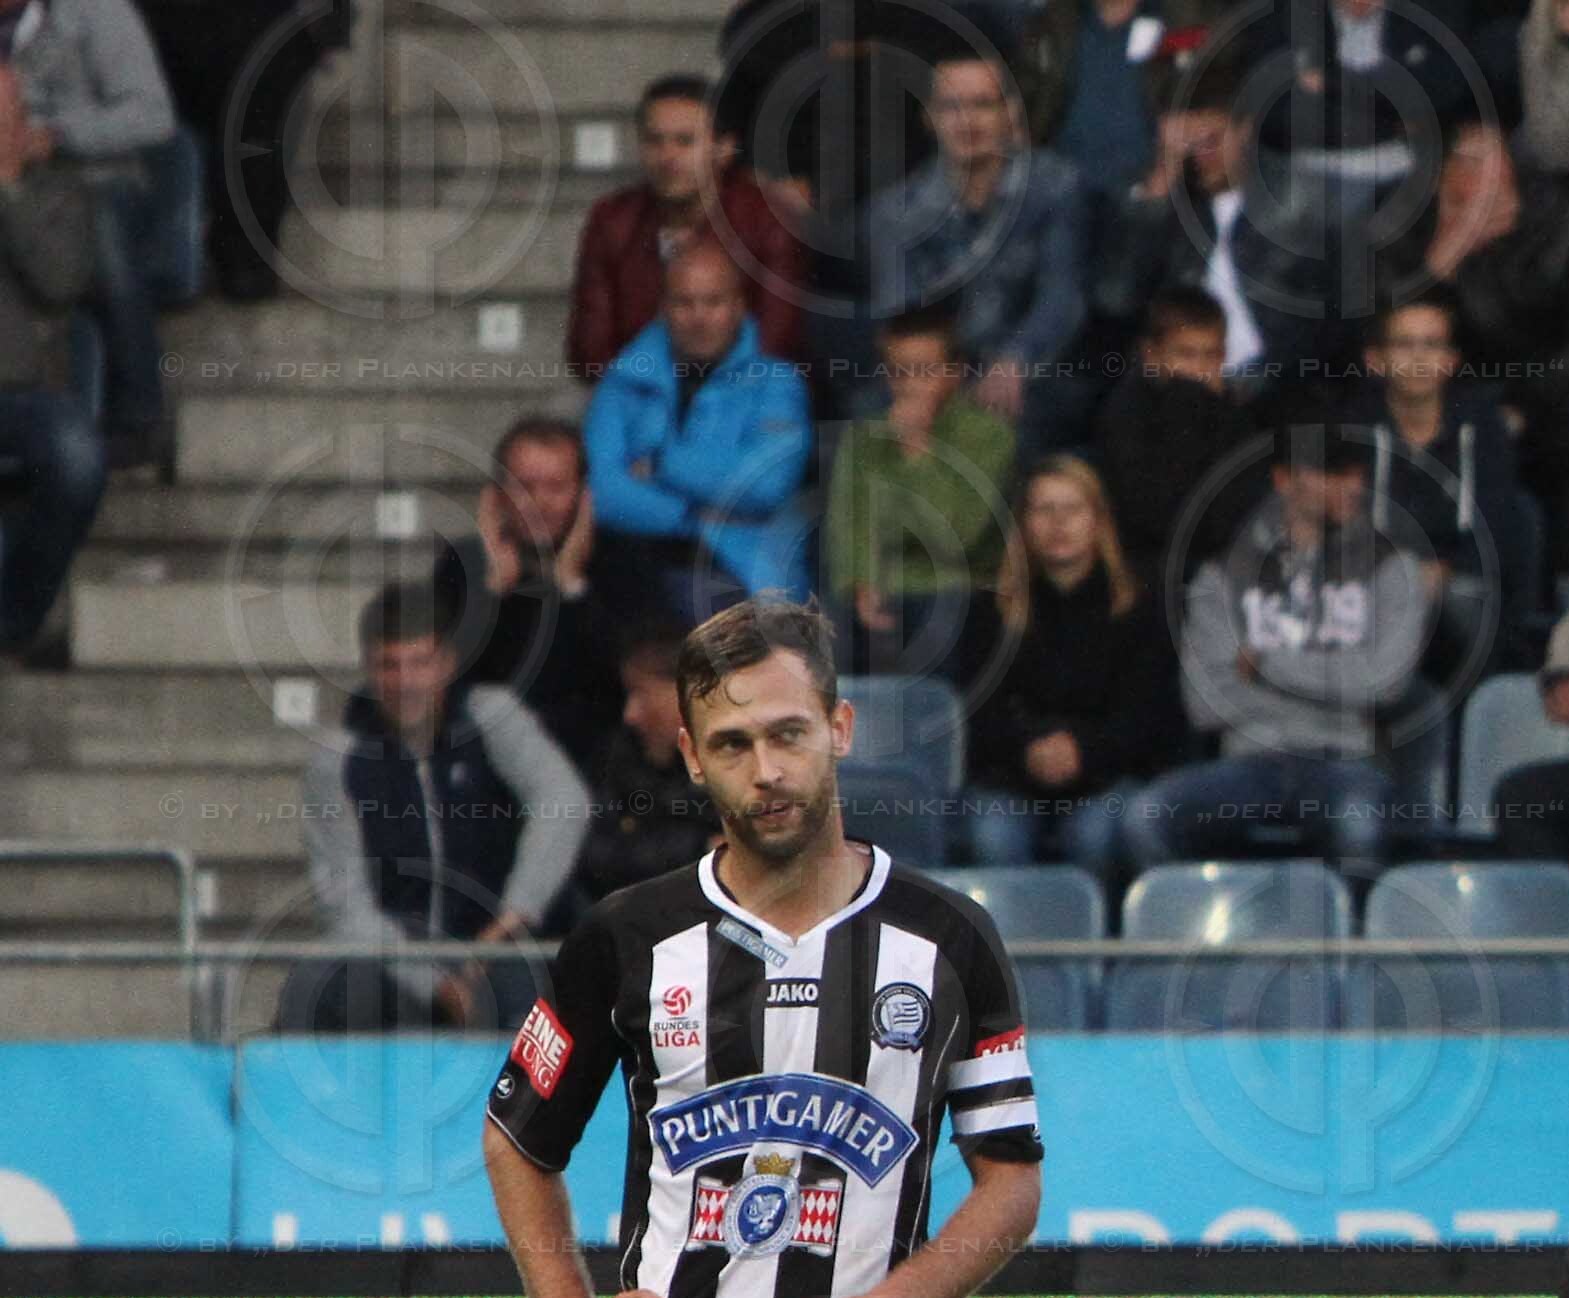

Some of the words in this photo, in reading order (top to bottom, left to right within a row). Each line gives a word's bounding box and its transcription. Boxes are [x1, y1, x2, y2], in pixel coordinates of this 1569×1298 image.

[767, 983, 818, 1003] JAKO
[653, 1020, 700, 1032] BUNDES
[653, 1031, 701, 1048] LIGA
[662, 1091, 894, 1167] PUNTIGAMER
